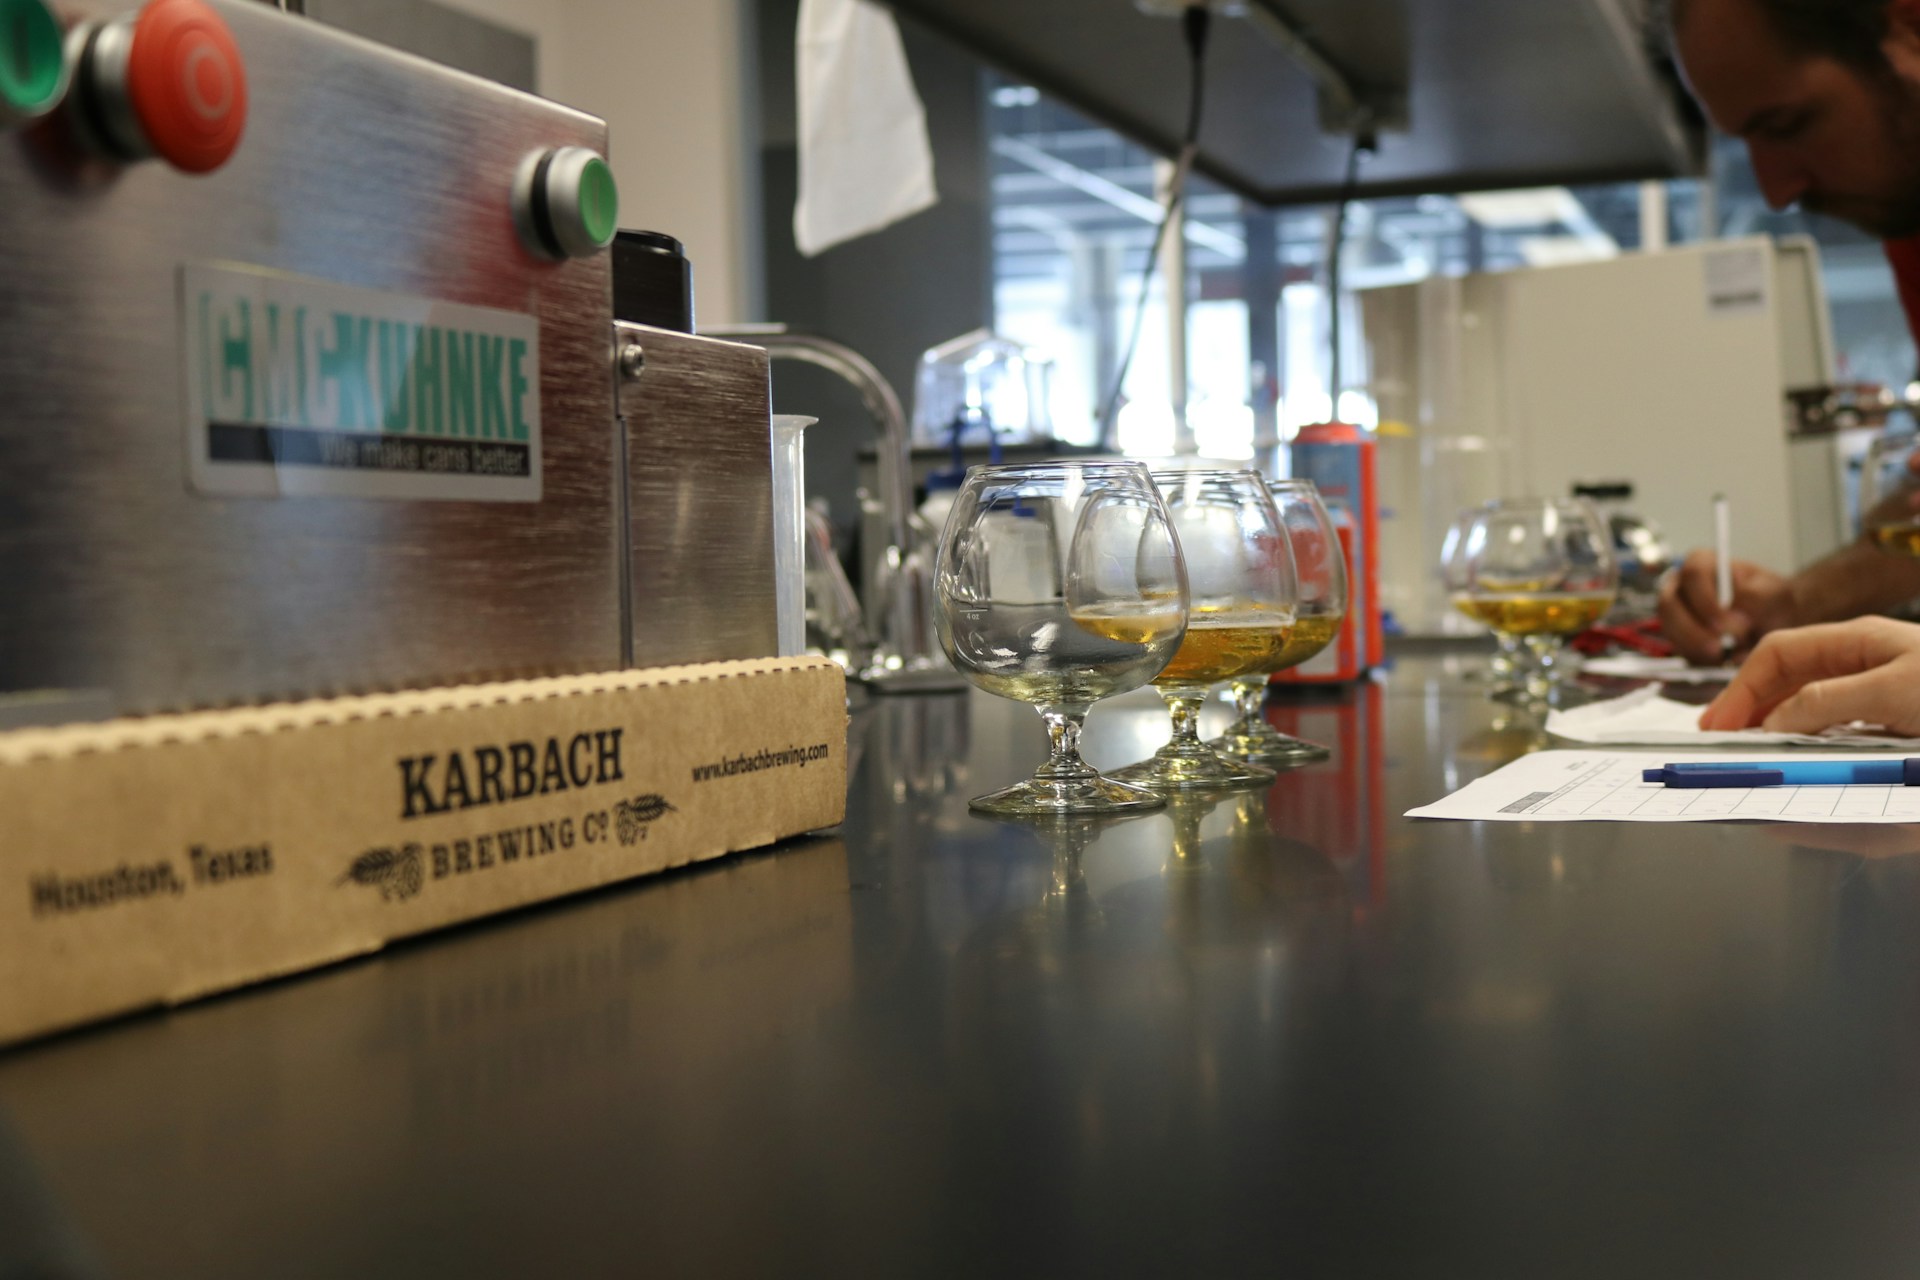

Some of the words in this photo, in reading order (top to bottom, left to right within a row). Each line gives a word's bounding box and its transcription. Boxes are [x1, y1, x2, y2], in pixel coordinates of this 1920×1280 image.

[361, 438, 419, 472] make
[422, 442, 470, 475] cans
[471, 443, 524, 476] better
[971, 613, 980, 621] oz
[397, 728, 625, 819] KARBACH
[692, 743, 828, 782] www.karbachbrewing.com
[432, 816, 575, 879] BREWING
[29, 861, 186, 919] Houston,
[188, 841, 273, 885] Texas
